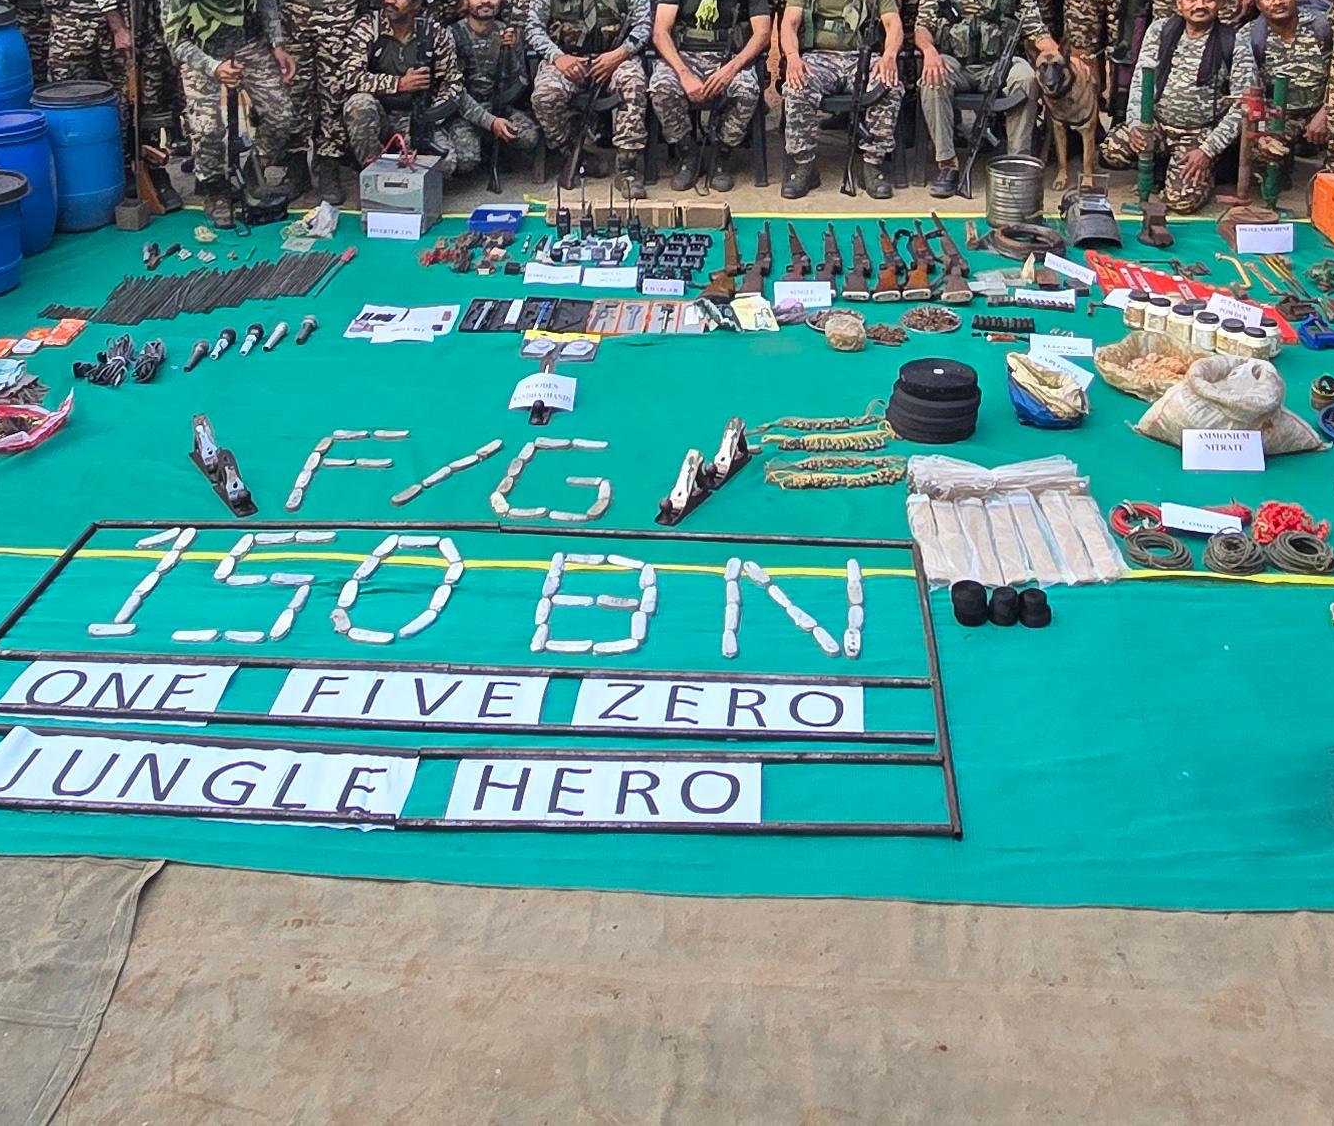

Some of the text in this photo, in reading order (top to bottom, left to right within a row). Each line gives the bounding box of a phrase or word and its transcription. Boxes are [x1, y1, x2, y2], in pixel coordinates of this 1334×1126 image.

[1196, 431, 1251, 441] AMMONIUM
[1204, 442, 1244, 452] NITRATE
[88, 526, 464, 644] 150
[25, 669, 845, 728] ONE FIVE ZERO
[473, 763, 741, 817] HERO
